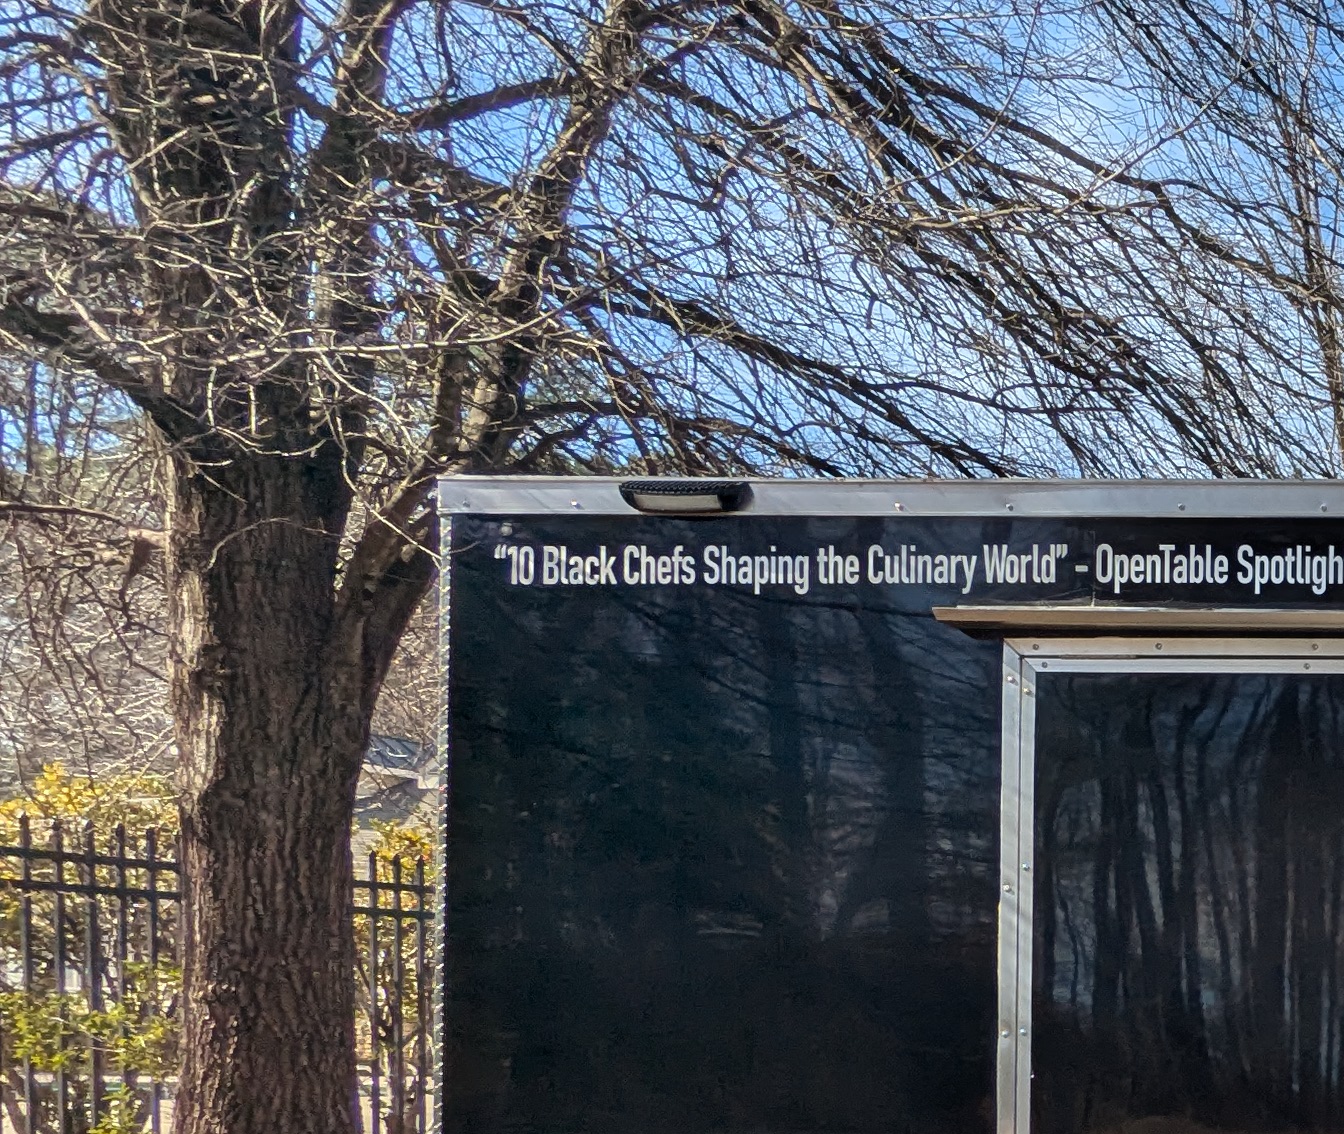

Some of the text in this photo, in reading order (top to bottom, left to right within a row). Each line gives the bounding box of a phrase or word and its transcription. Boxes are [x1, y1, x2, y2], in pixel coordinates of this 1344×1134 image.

[543, 544, 617, 585] Black
[623, 544, 696, 585] Chefs
[703, 545, 810, 594] Shaping
[816, 545, 860, 584] the
[867, 544, 977, 594] Culinary
[1095, 543, 1229, 593] OpenTable
